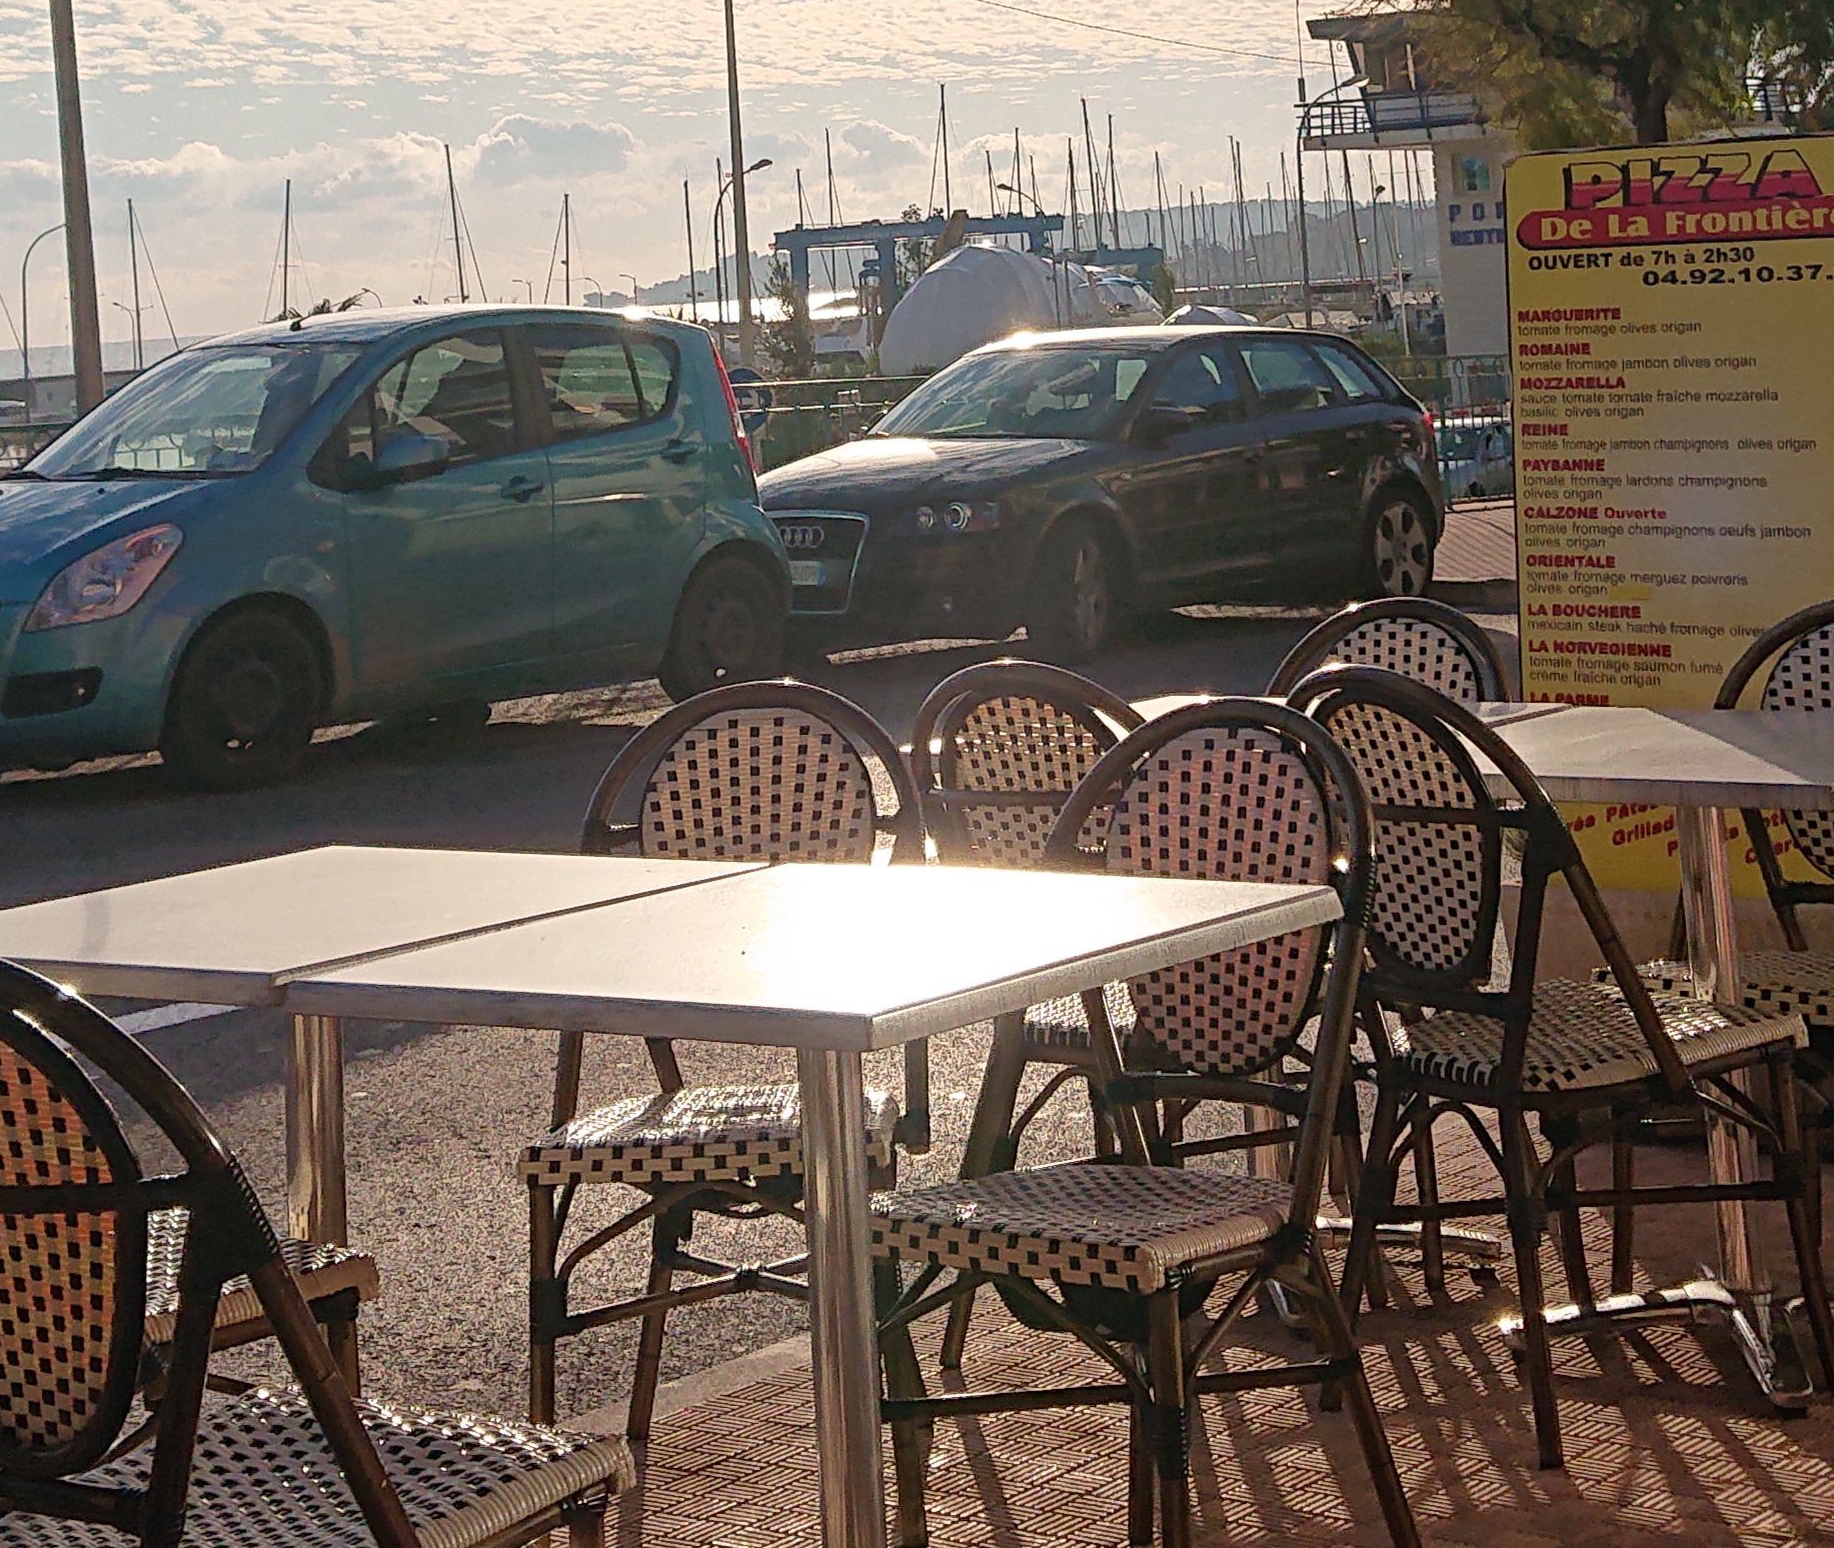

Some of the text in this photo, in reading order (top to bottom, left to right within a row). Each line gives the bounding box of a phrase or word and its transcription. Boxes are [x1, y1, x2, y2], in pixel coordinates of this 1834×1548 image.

[1563, 149, 1824, 211] PIZZA
[1541, 216, 1593, 242] De
[1608, 213, 1650, 238] La
[1528, 246, 1756, 271] OUVERT de 7h à 2h30
[1518, 308, 1621, 323] MARGUERITE
[1518, 320, 1701, 337] tomate fromage olives origan
[1519, 342, 1591, 356] ROMAINE
[1519, 355, 1757, 371] tomate fromage jambon olives origan
[1520, 376, 1625, 390] MOZZARELLA
[1520, 386, 1779, 403] sauce tomate tomate fraîche mozzarella
[1521, 405, 1644, 419] basilic olives origan
[1521, 423, 1569, 437] REINE
[1522, 437, 1816, 452] tomate fromage jambon champignons olives origan
[1522, 458, 1605, 472] PAYSANNE
[1523, 473, 1767, 490] tomate fromage lardons champignons
[1523, 488, 1602, 501] olives origan
[1524, 506, 1599, 520] CALZONE
[1604, 507, 1667, 520] Ouverte
[1525, 523, 1811, 539] tomate fromage champignons oeufs jambon
[1525, 537, 1605, 551] olives origan
[1526, 554, 1616, 569] ORIENTALE
[1527, 570, 1748, 587] tomate fromage merguez poivrons
[1526, 582, 1608, 597] olives origan
[1528, 603, 1548, 616] LA
[1528, 619, 1582, 632] mexicain
[1589, 620, 1622, 633] steak
[1626, 620, 1666, 635] haché
[1670, 621, 1725, 639] fromage
[1528, 640, 1549, 653] LA
[1529, 656, 1724, 675] tomate fromage saumon fumé
[1620, 672, 1662, 687] origan
[1530, 691, 1551, 703] LA
